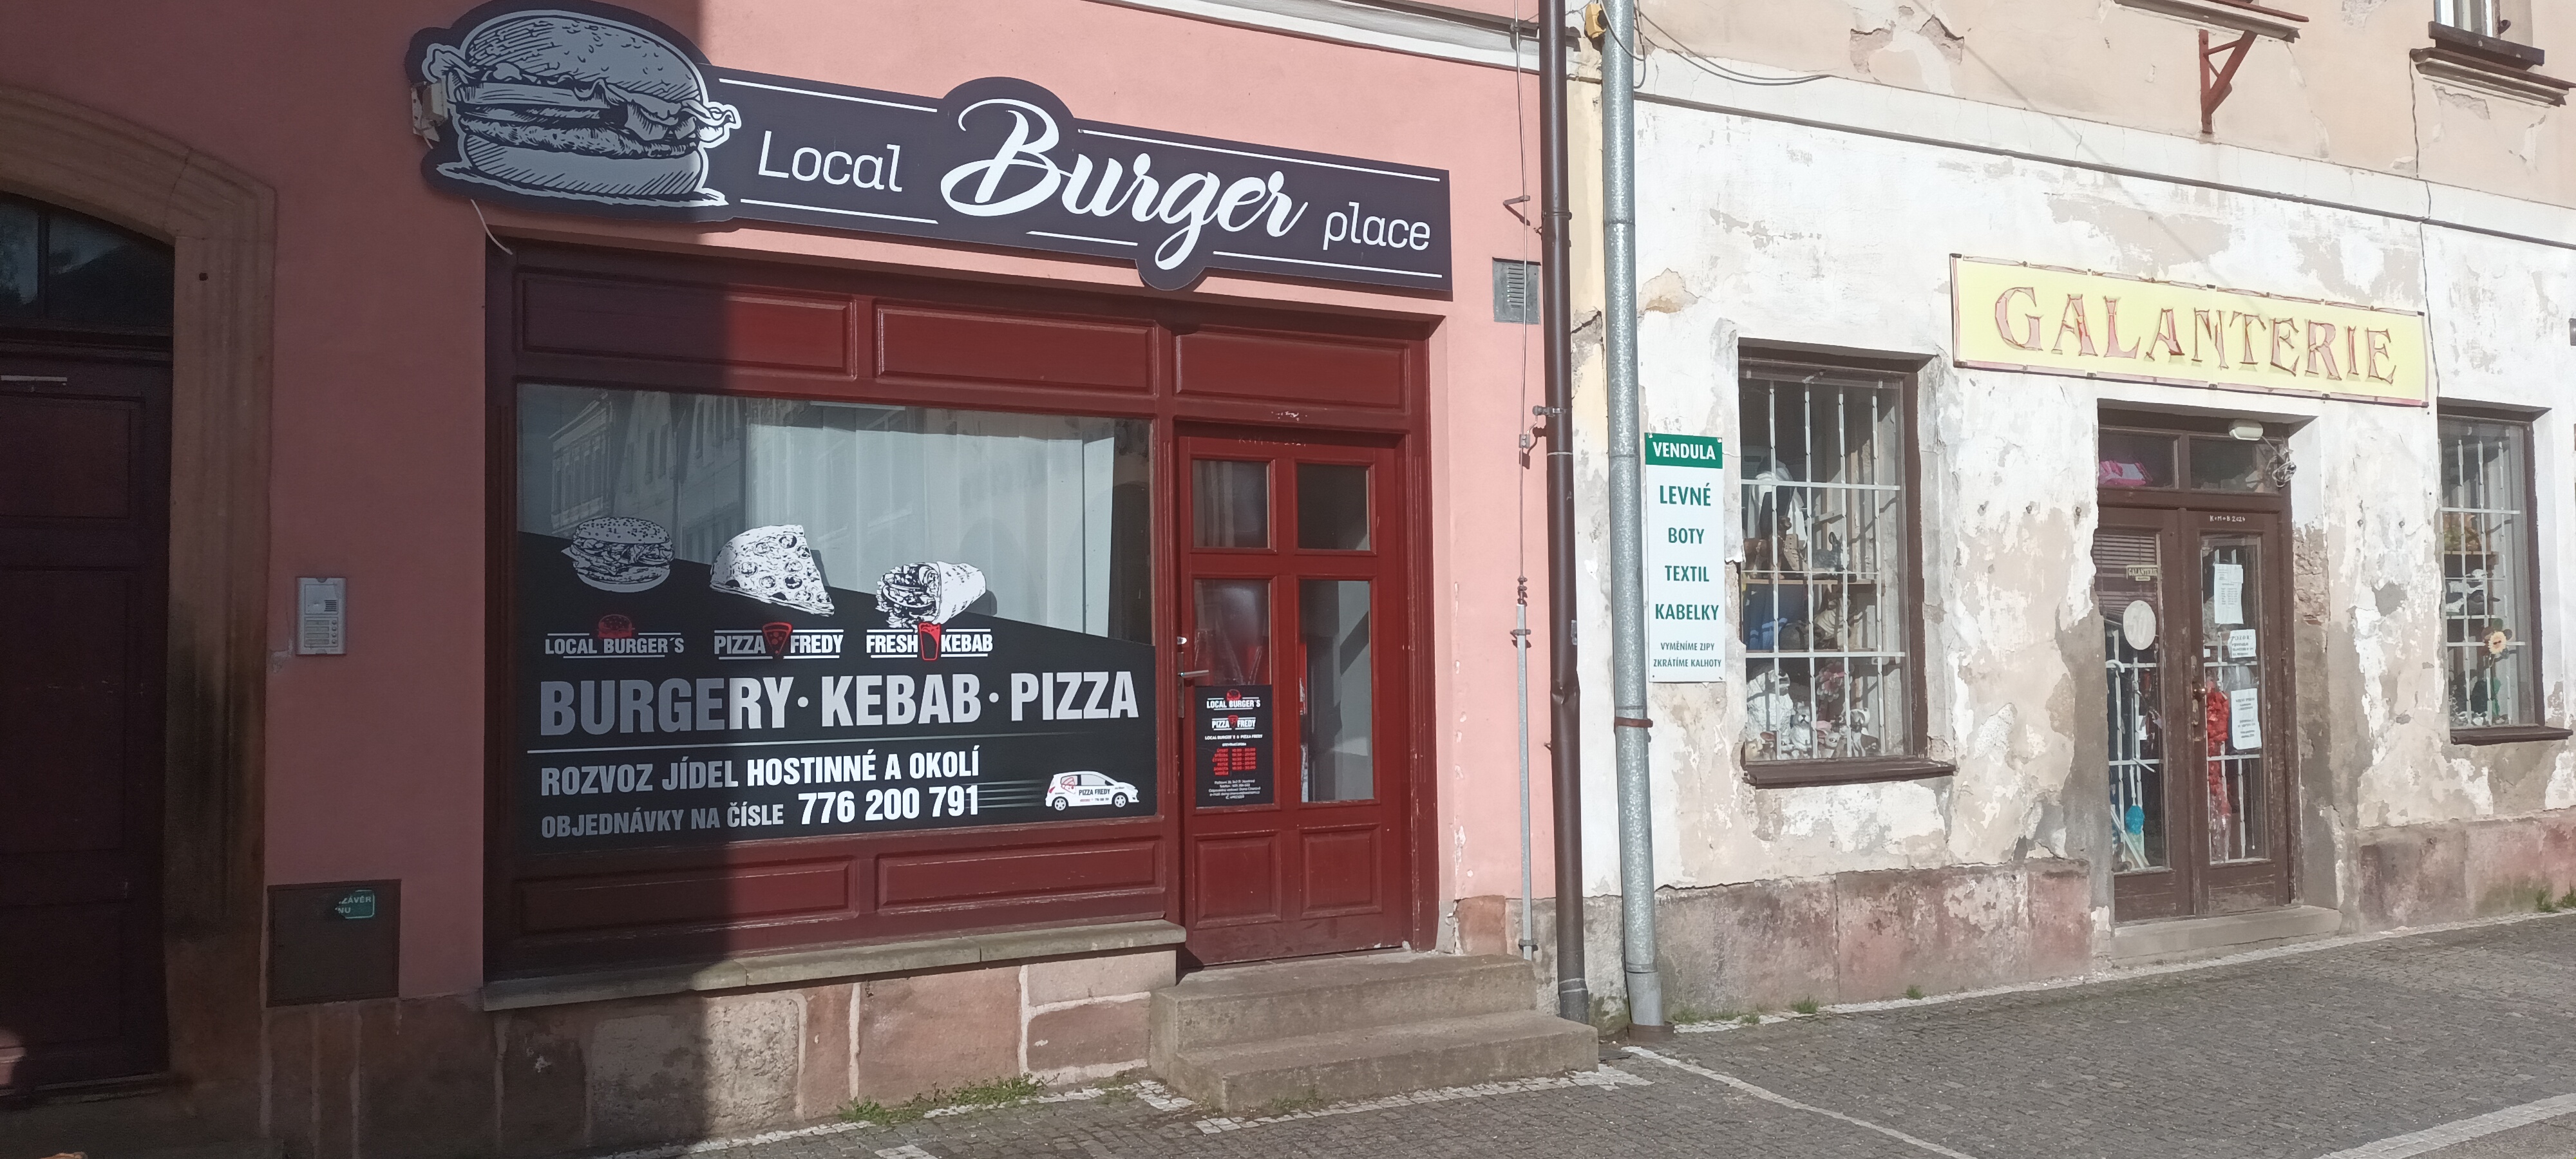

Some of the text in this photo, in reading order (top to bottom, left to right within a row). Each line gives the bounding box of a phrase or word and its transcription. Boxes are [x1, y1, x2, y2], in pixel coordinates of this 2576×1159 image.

[758, 99, 1431, 270] Local Burger place
[1995, 287, 2396, 385] GALANTERIE
[1653, 441, 1716, 460] VENDULA
[1660, 482, 1711, 506] LEVNÉ
[1668, 527, 1705, 545] BOTY
[1665, 565, 1710, 582] TEXTIL
[1655, 603, 1719, 621] KABELKY
[545, 638, 597, 655] LOCAL
[714, 634, 844, 654] PIZZA FREDY
[866, 634, 993, 654] FRESH KEBAB
[1660, 641, 1715, 651] VYMĚNÍME ZIPY
[1653, 657, 1721, 667] ZKRÁTÍME KALHOTY
[540, 671, 1139, 735] BURGERY KEBAB PIZZA
[1206, 701, 1227, 709] LOCAL
[1211, 719, 1256, 729] PIZZA FREDY
[541, 745, 980, 796] ROZVOZ JÍDEL HOSTINNÉ A OKOLÍ
[542, 785, 979, 838] OBJEDNÁVKY NA ČÍSLE 776 200 791
[339, 894, 372, 904] ZÁVĚR
